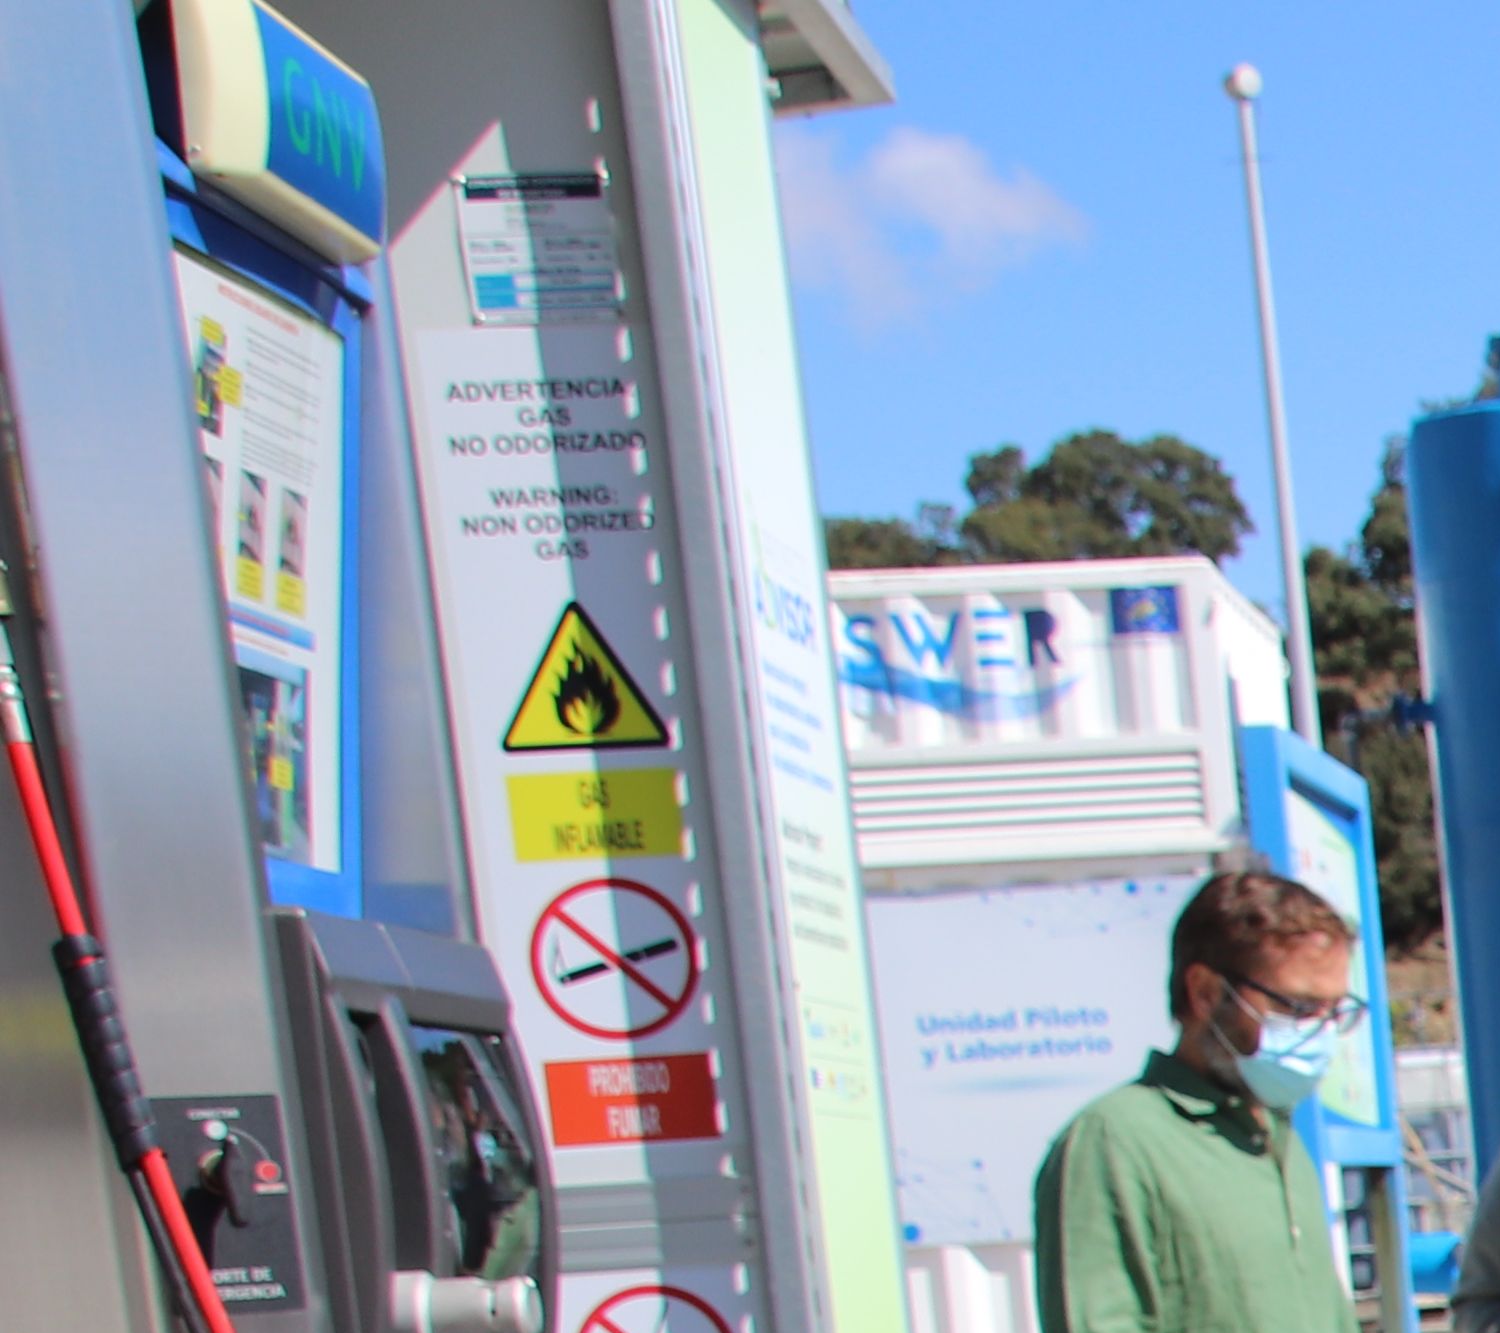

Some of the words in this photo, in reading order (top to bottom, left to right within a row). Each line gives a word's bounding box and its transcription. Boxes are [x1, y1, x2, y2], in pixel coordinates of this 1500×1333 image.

[282, 58, 366, 191] GNV
[517, 407, 571, 427] GAS
[450, 436, 486, 456] NO
[494, 431, 646, 455] ODORIZADO
[462, 516, 516, 536] NON
[524, 511, 655, 534] ODORIZED
[536, 541, 589, 560] GAS
[843, 608, 1058, 666] SWER
[579, 779, 609, 810] GAS
[916, 1012, 1015, 1035] Unidad
[1025, 1007, 1108, 1028] Piloto
[945, 1037, 1114, 1063] Laboratorio
[589, 1062, 670, 1096] PROHIBIDO
[608, 1105, 662, 1138] FUMAR
[250, 1266, 272, 1282] DE
